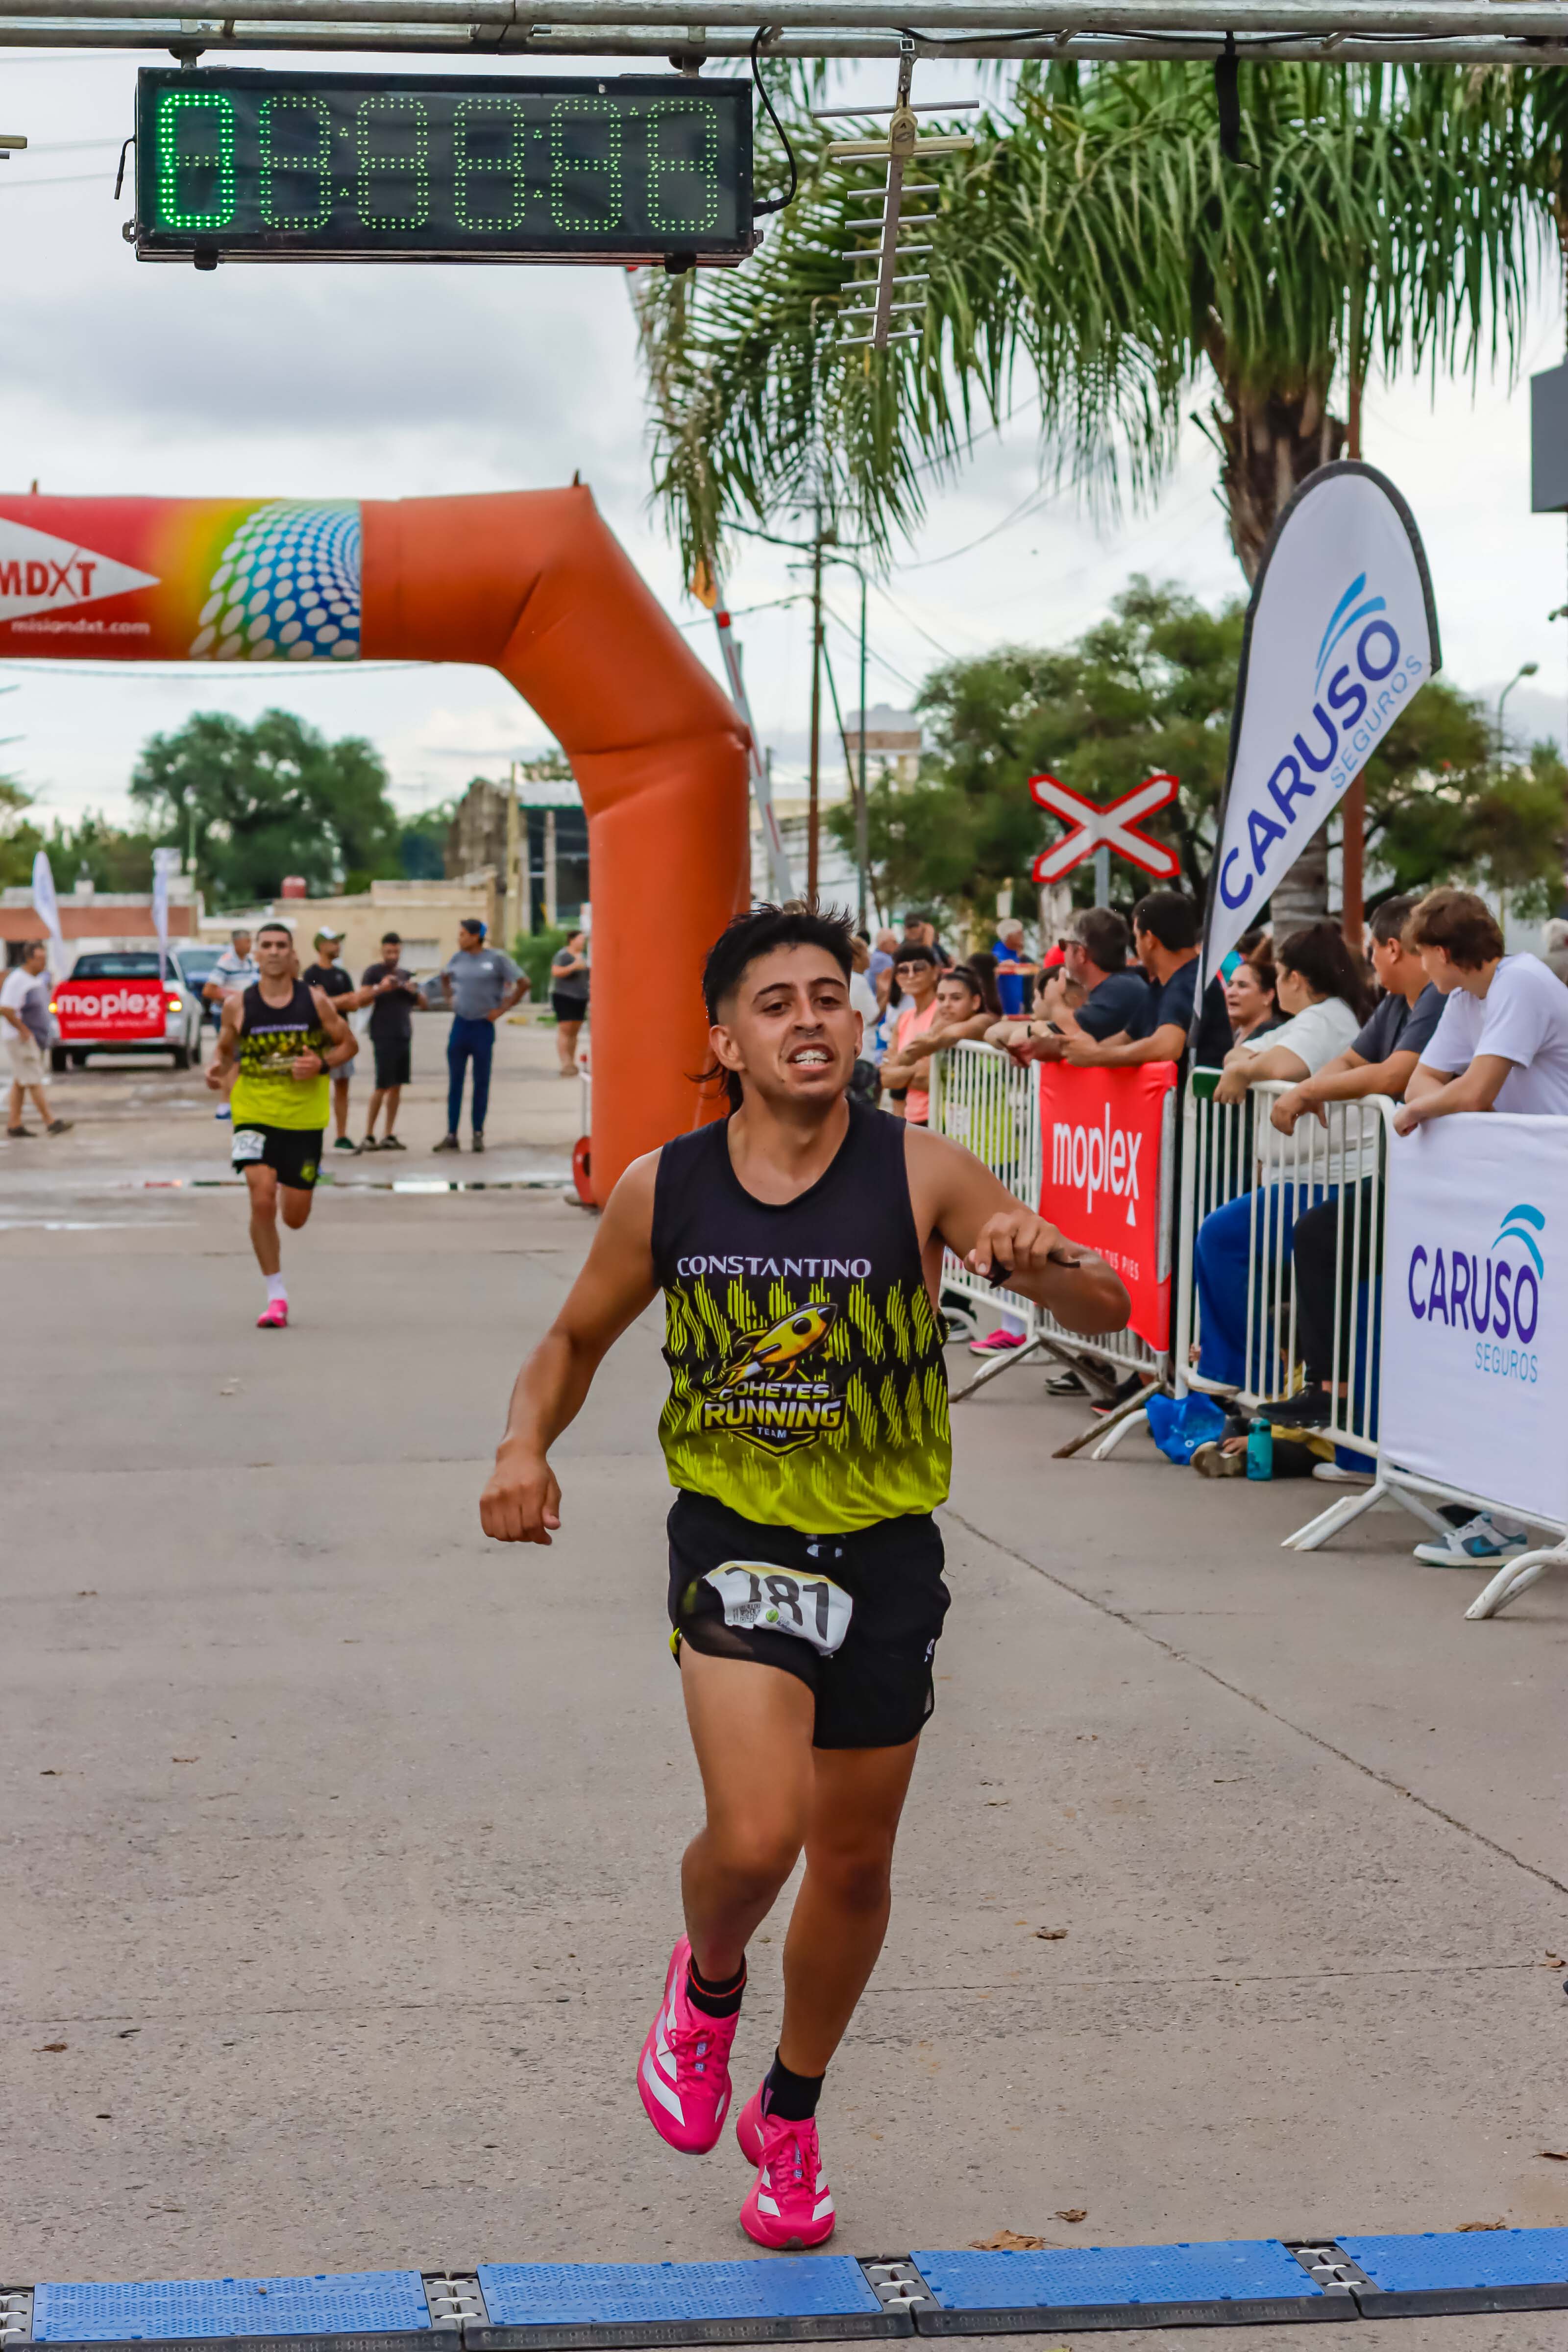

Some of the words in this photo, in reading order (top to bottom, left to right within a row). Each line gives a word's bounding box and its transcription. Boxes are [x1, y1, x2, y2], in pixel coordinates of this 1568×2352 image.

[1330, 655, 1423, 788] SEGUROS
[1220, 619, 1400, 909] CARUSO
[57, 988, 160, 1019] moplex
[1053, 1102, 1142, 1213] moplex
[677, 1255, 872, 1278] CONSTANTINO
[1409, 1245, 1538, 1344] CARUSO
[1475, 1342, 1538, 1383] SEGUROS
[719, 1381, 830, 1401] COHETES
[704, 1399, 841, 1428] RUNNING
[757, 1426, 787, 1439] TEAM
